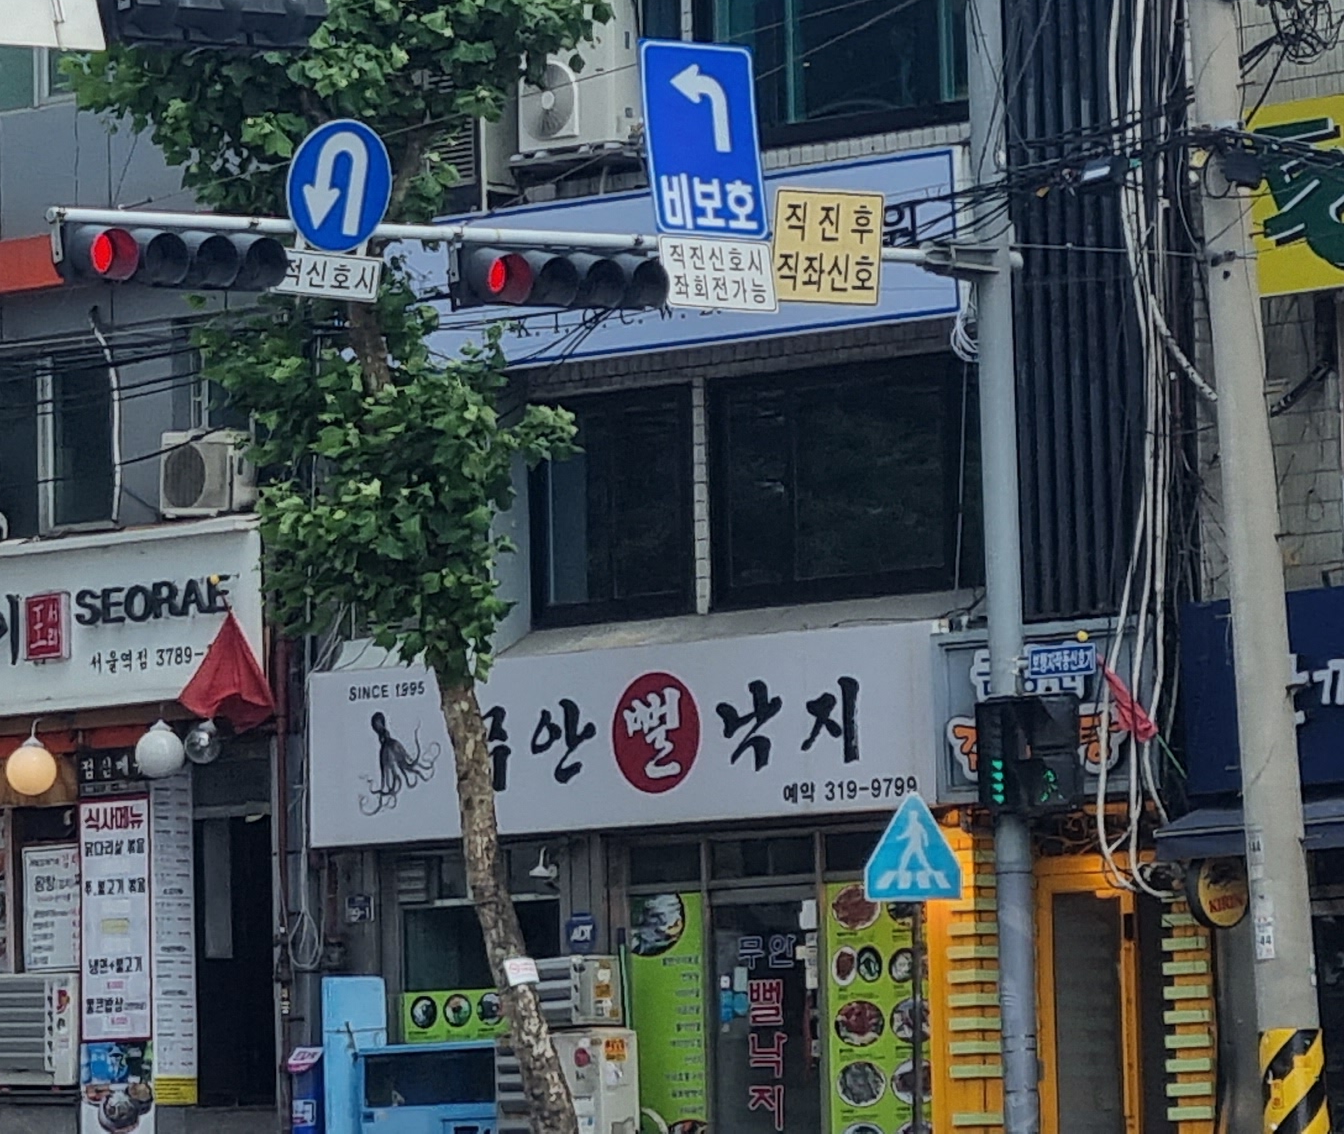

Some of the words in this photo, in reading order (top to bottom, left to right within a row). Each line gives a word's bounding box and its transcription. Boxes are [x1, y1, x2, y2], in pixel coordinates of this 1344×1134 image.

[659, 172, 759, 231] 비보호
[669, 244, 764, 276] 직진신호시
[777, 252, 875, 293] 직좌신호
[285, 258, 376, 294] 적신호시
[673, 274, 768, 304] 좌회전가능
[74, 574, 232, 626] SEORAE
[90, 648, 148, 674] 서울역점
[156, 644, 213, 667] 3789-
[349, 682, 389, 701] SINCE
[396, 680, 426, 697] 1995
[715, 676, 860, 772] 낙지
[783, 783, 816, 804] 예약
[824, 776, 918, 801] 319-9799
[84, 804, 145, 833] 식사메뉴
[1208, 893, 1244, 914] KIRIN
[571, 924, 593, 942] ADT
[738, 933, 797, 970] 무안
